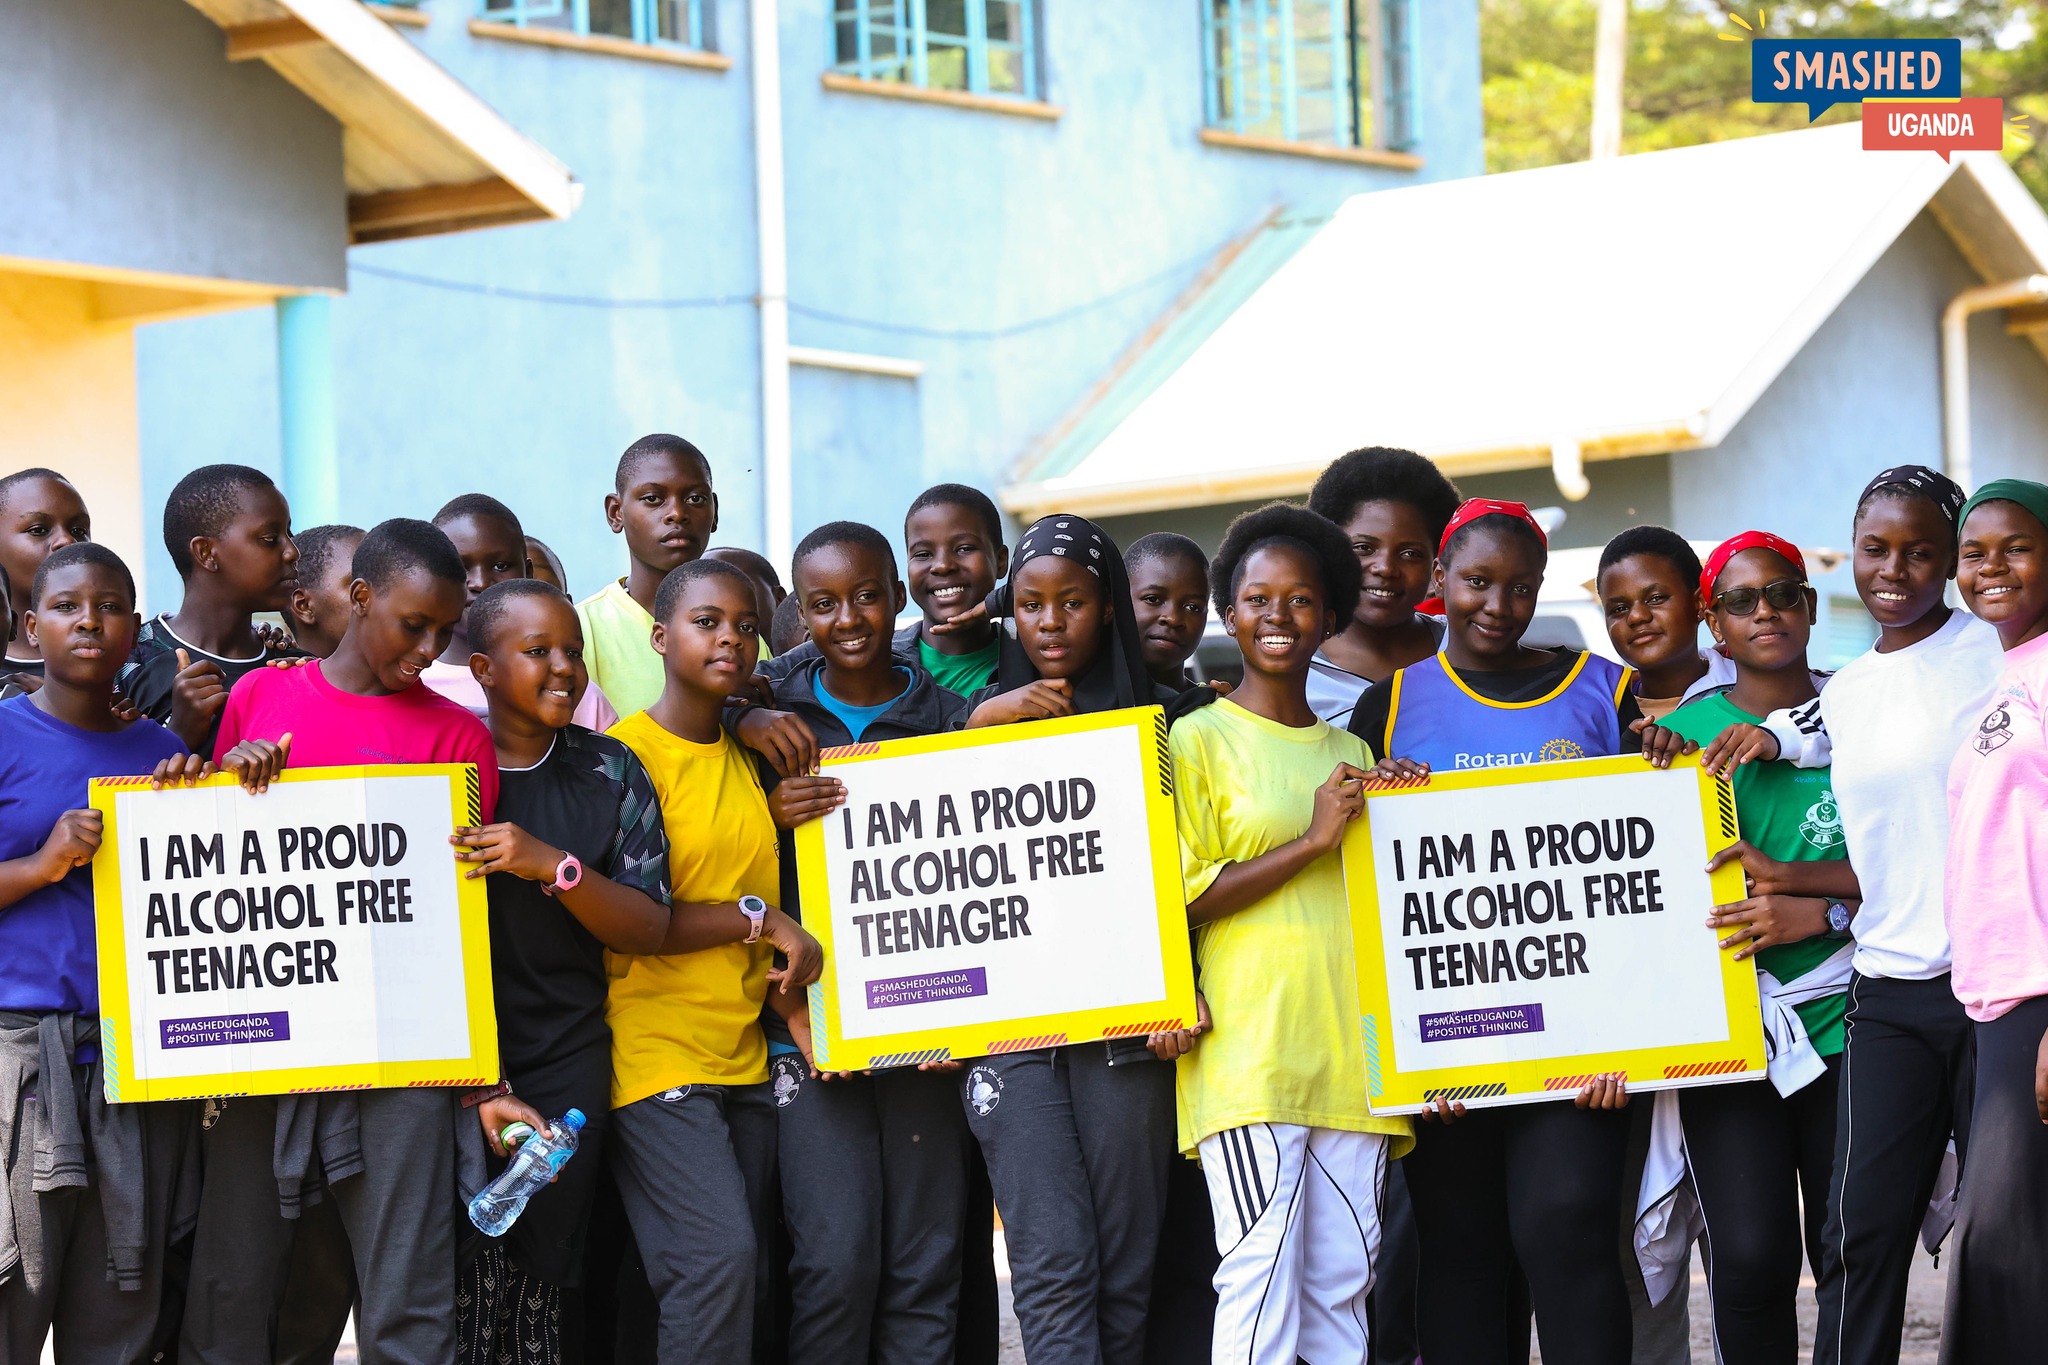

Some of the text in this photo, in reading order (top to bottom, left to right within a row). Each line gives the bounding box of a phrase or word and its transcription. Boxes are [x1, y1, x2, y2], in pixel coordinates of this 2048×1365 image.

[1455, 751, 1534, 769] Rotary
[842, 777, 1096, 850] I AM A PROUD
[139, 822, 408, 882] I AM A PROUD
[850, 829, 1104, 904] ALCOHOL FREE
[1393, 816, 1655, 882] I AM A PROUD
[145, 878, 414, 939] ALCOHOL FREE
[852, 894, 1032, 957] TEENAGER
[1402, 869, 1664, 937] ALCOHOL FREE
[147, 939, 339, 995] TEENAGER
[871, 973, 969, 994] #SMASHEDUGANDA
[1404, 932, 1590, 991] TEENAGER
[872, 984, 973, 1005] #POSITIVE THINKING
[1425, 1009, 1525, 1027] #SMASHEDUGANDA
[166, 1016, 271, 1034] #SMASHEDUGANDA
[166, 1027, 275, 1045] #POSITIVE THINKING
[1426, 1020, 1529, 1039] #POSITIVE THINKING
